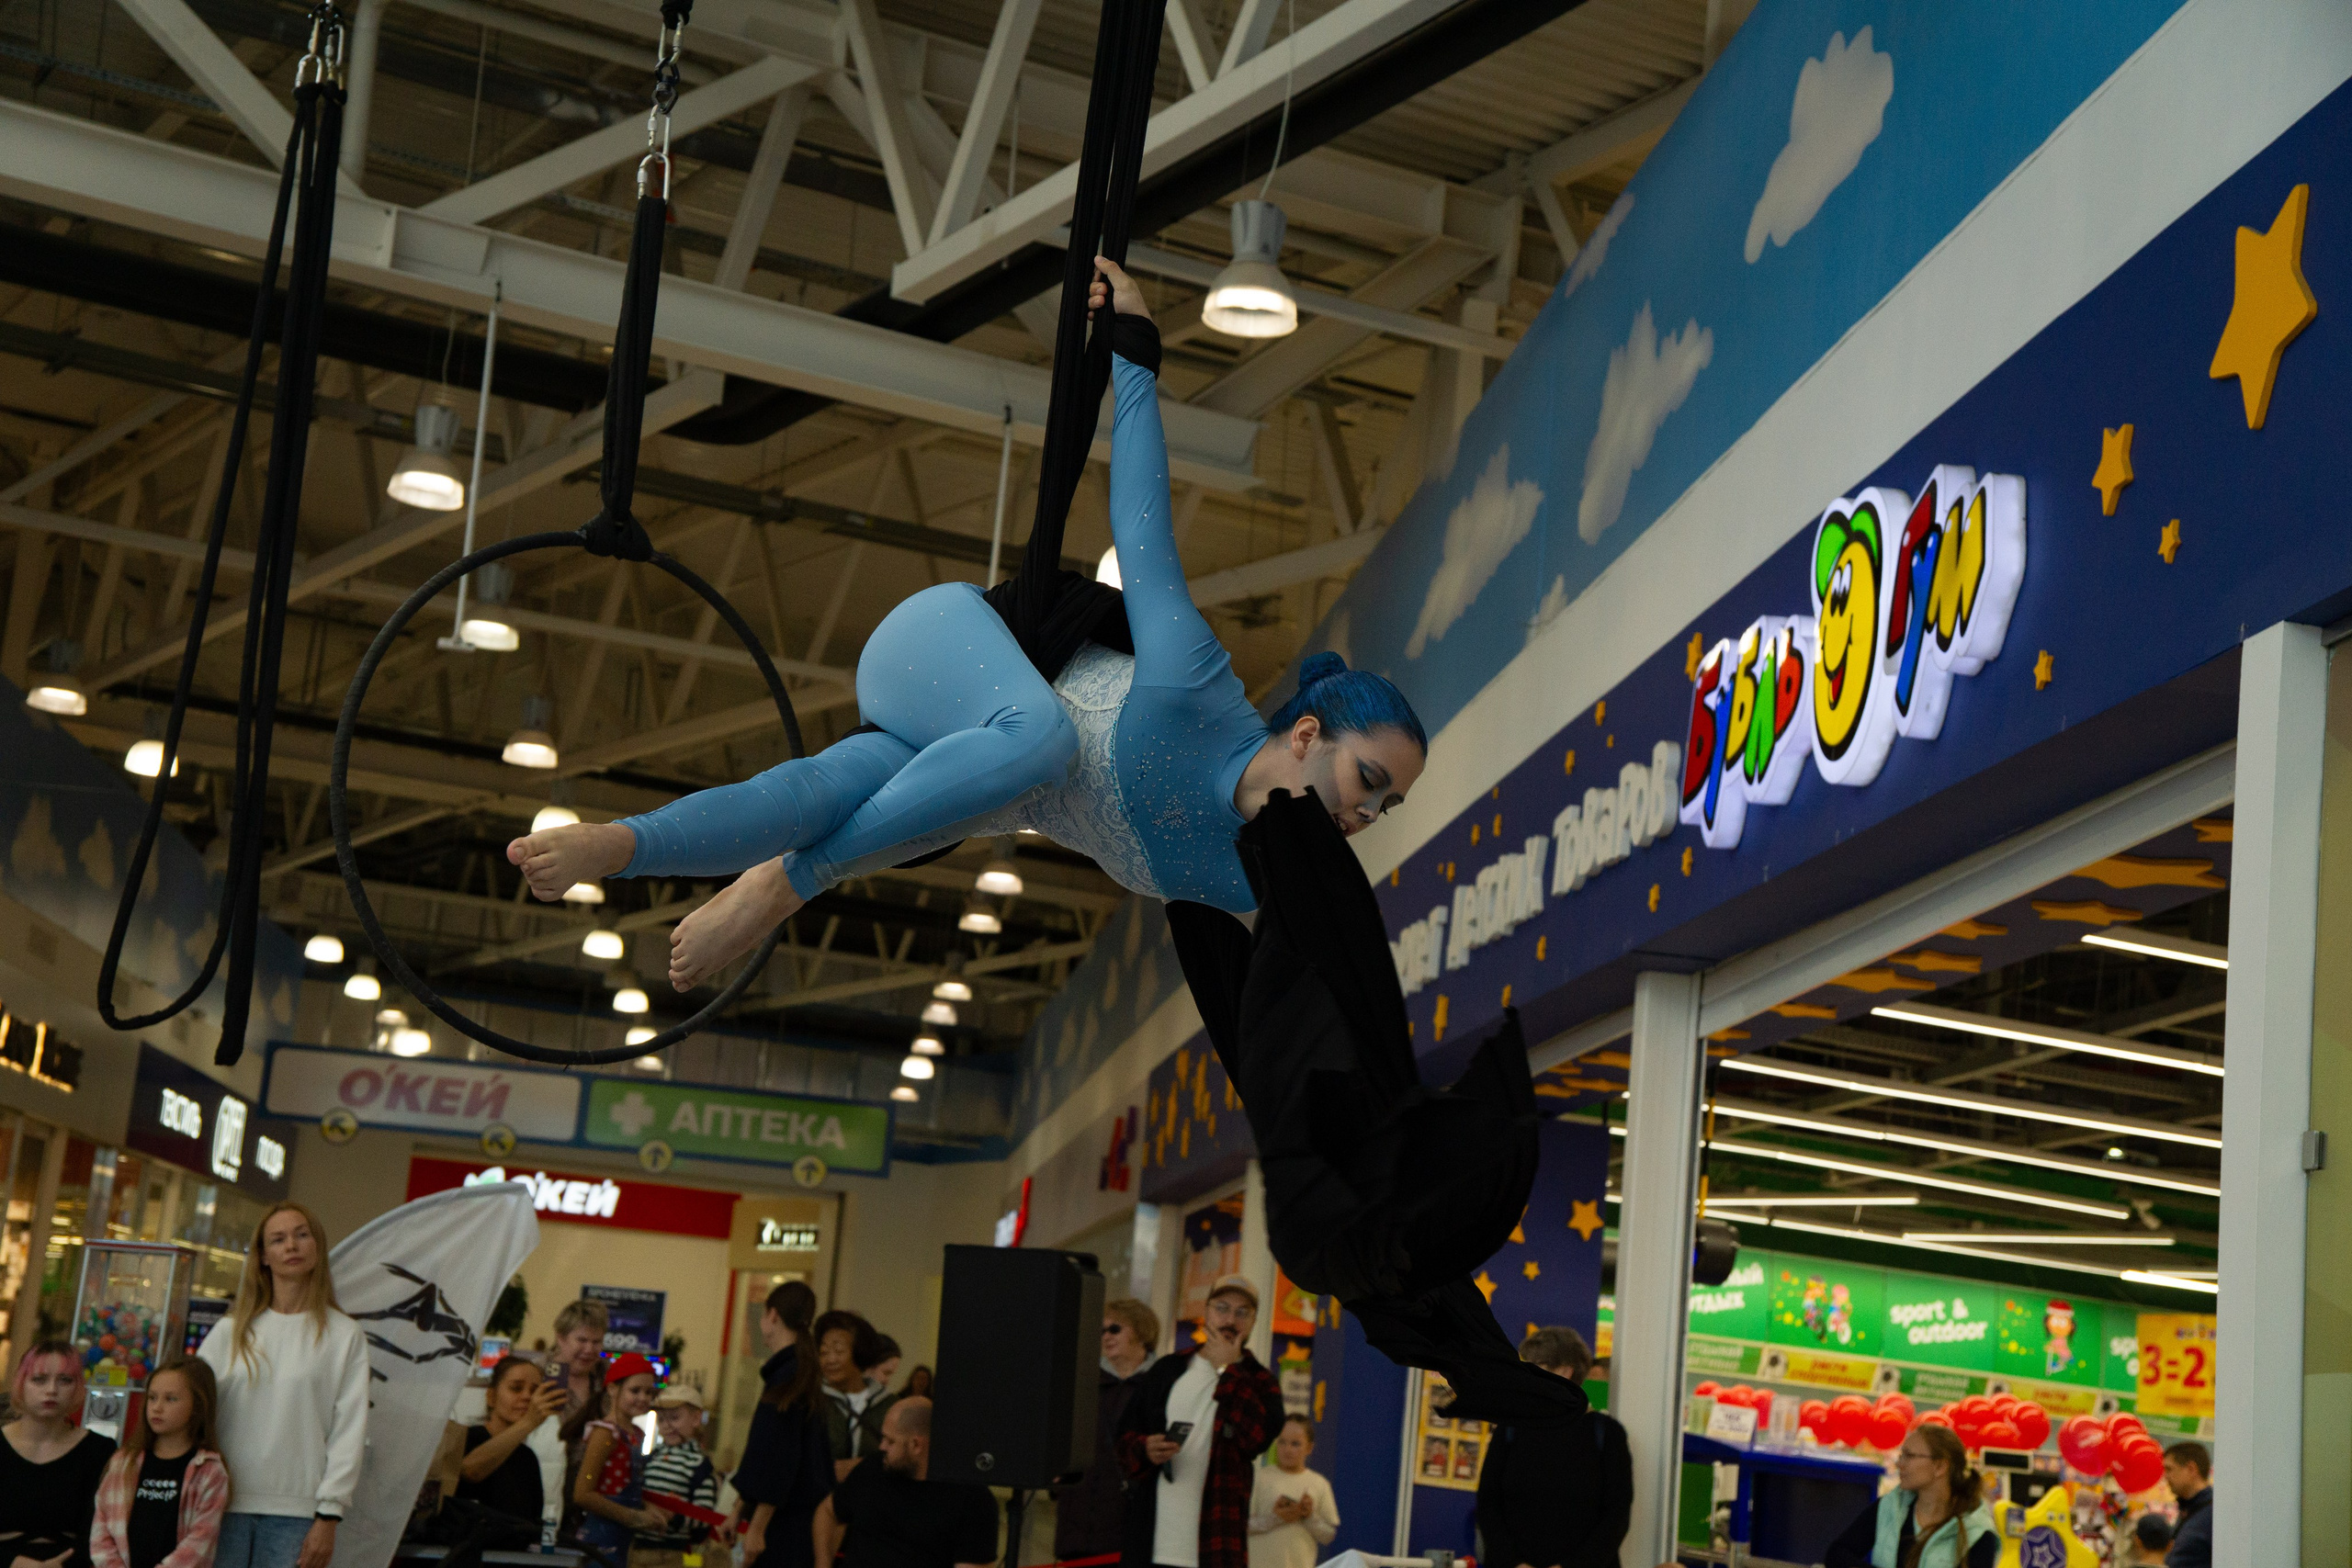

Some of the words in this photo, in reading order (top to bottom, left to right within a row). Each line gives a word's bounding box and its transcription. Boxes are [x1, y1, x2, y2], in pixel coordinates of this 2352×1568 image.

[669, 1101, 846, 1150] АПТЕКА
[1889, 1299, 1947, 1329] sport
[1951, 1297, 1970, 1320] &
[1906, 1319, 1989, 1346] outdoor
